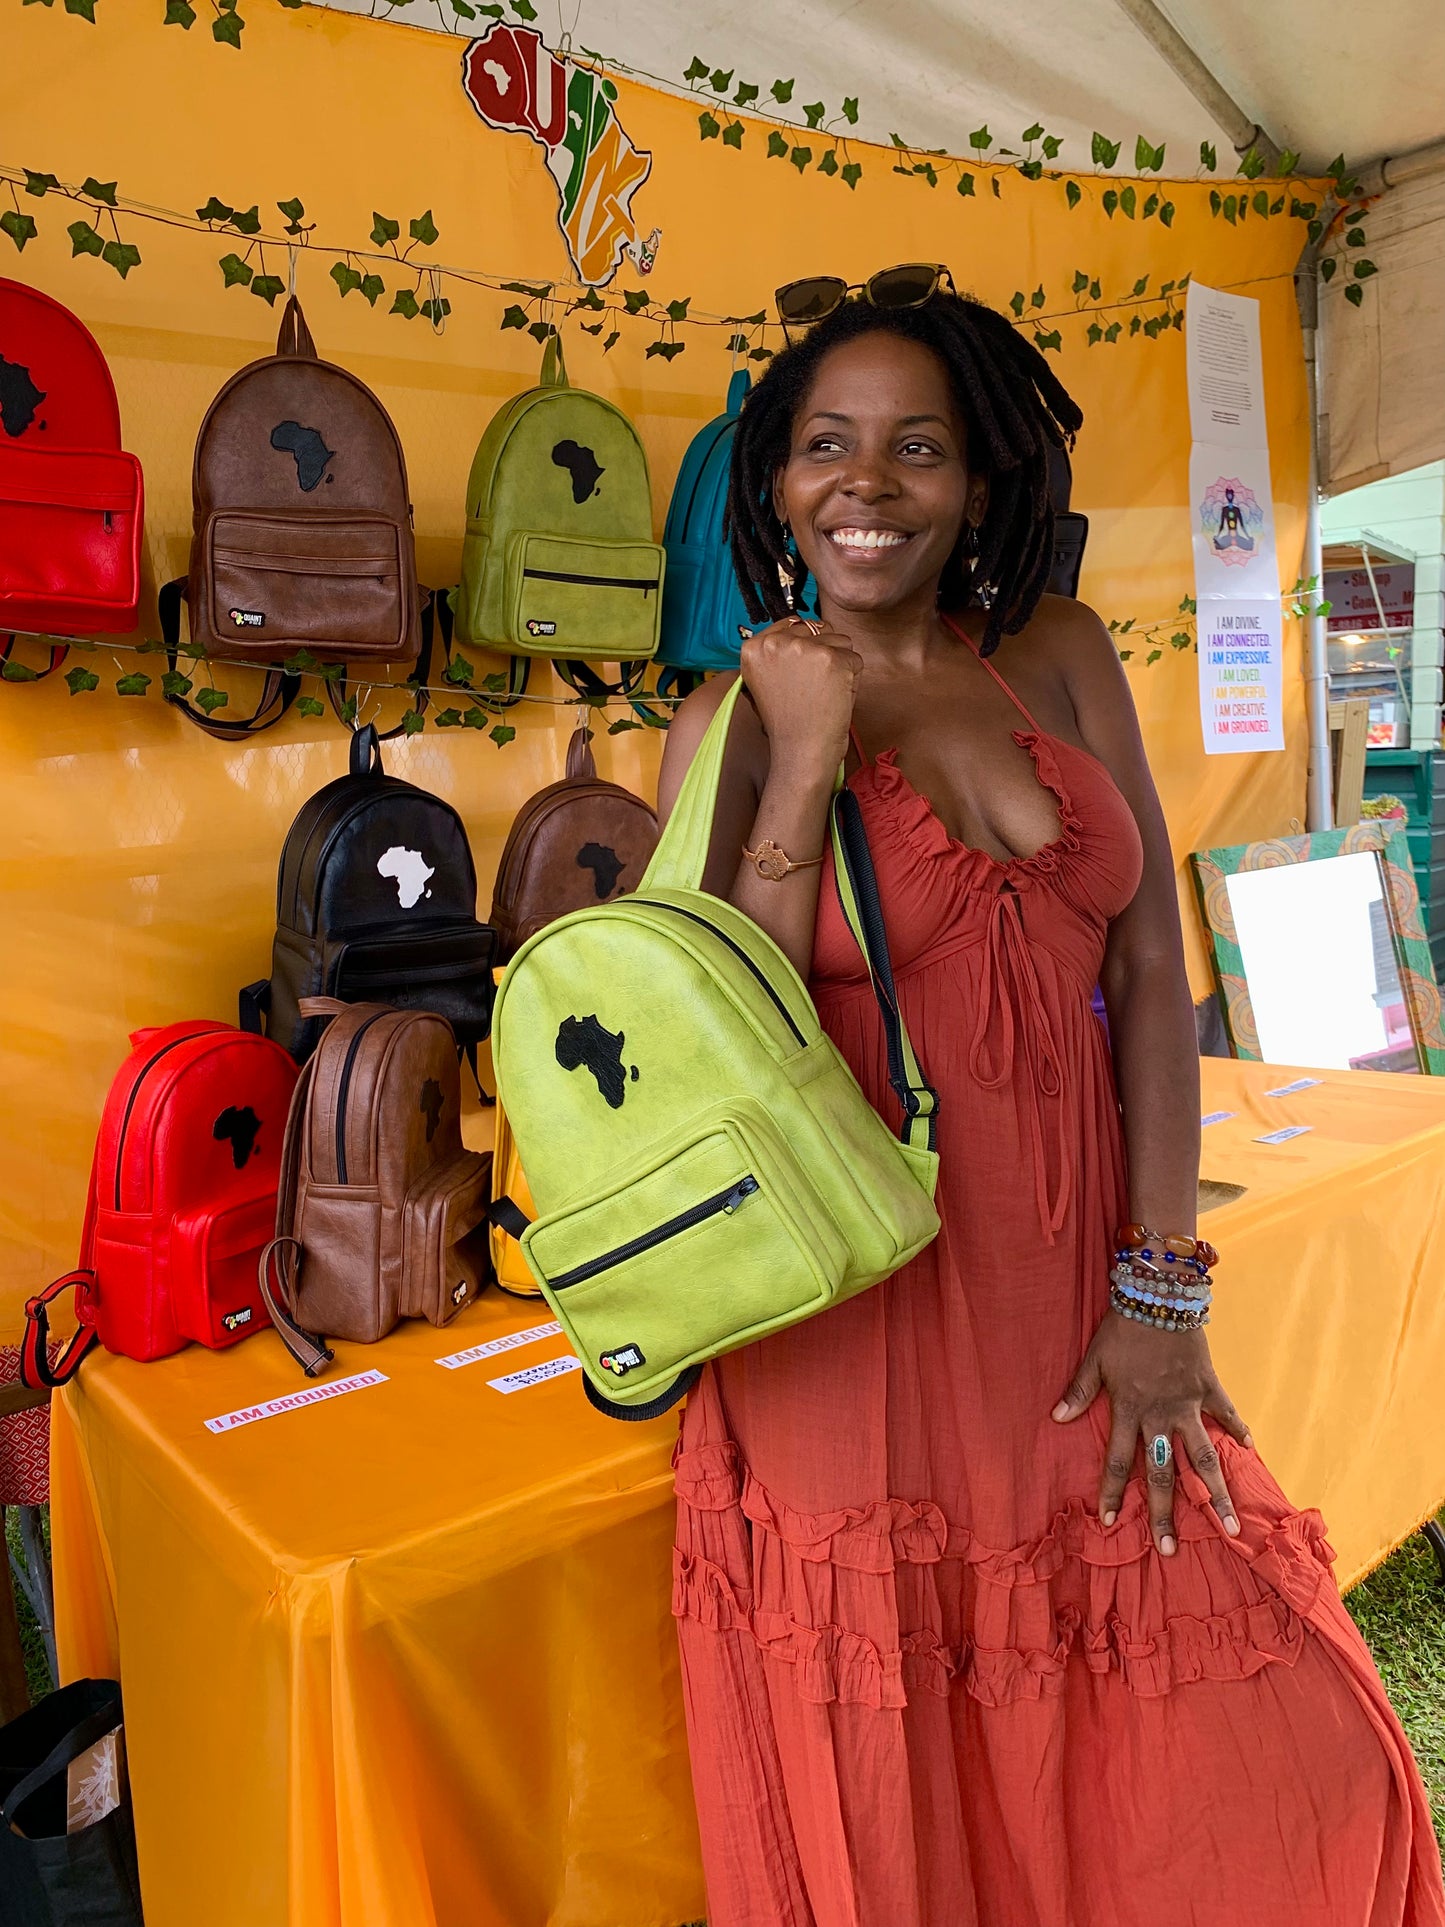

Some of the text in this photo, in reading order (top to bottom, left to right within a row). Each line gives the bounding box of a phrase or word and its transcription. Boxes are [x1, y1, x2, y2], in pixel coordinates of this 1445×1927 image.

[1352, 573, 1390, 587] Shrmp
[1217, 616, 1220, 630] I
[1221, 616, 1234, 630] AM
[1208, 634, 1211, 647] I
[1212, 634, 1224, 647] AM
[1208, 651, 1211, 664] I
[1212, 651, 1224, 664] AM
[1219, 669, 1222, 682] I
[1223, 669, 1235, 682] AM
[1216, 687, 1227, 700] AM
[1214, 704, 1218, 717] I
[1219, 704, 1231, 717] AM
[1213, 721, 1217, 735] I
[1218, 721, 1229, 734] AM
[442, 1358, 453, 1366] I
[454, 1347, 487, 1363] AM
[214, 1375, 377, 1428] I AM GROUNDED
